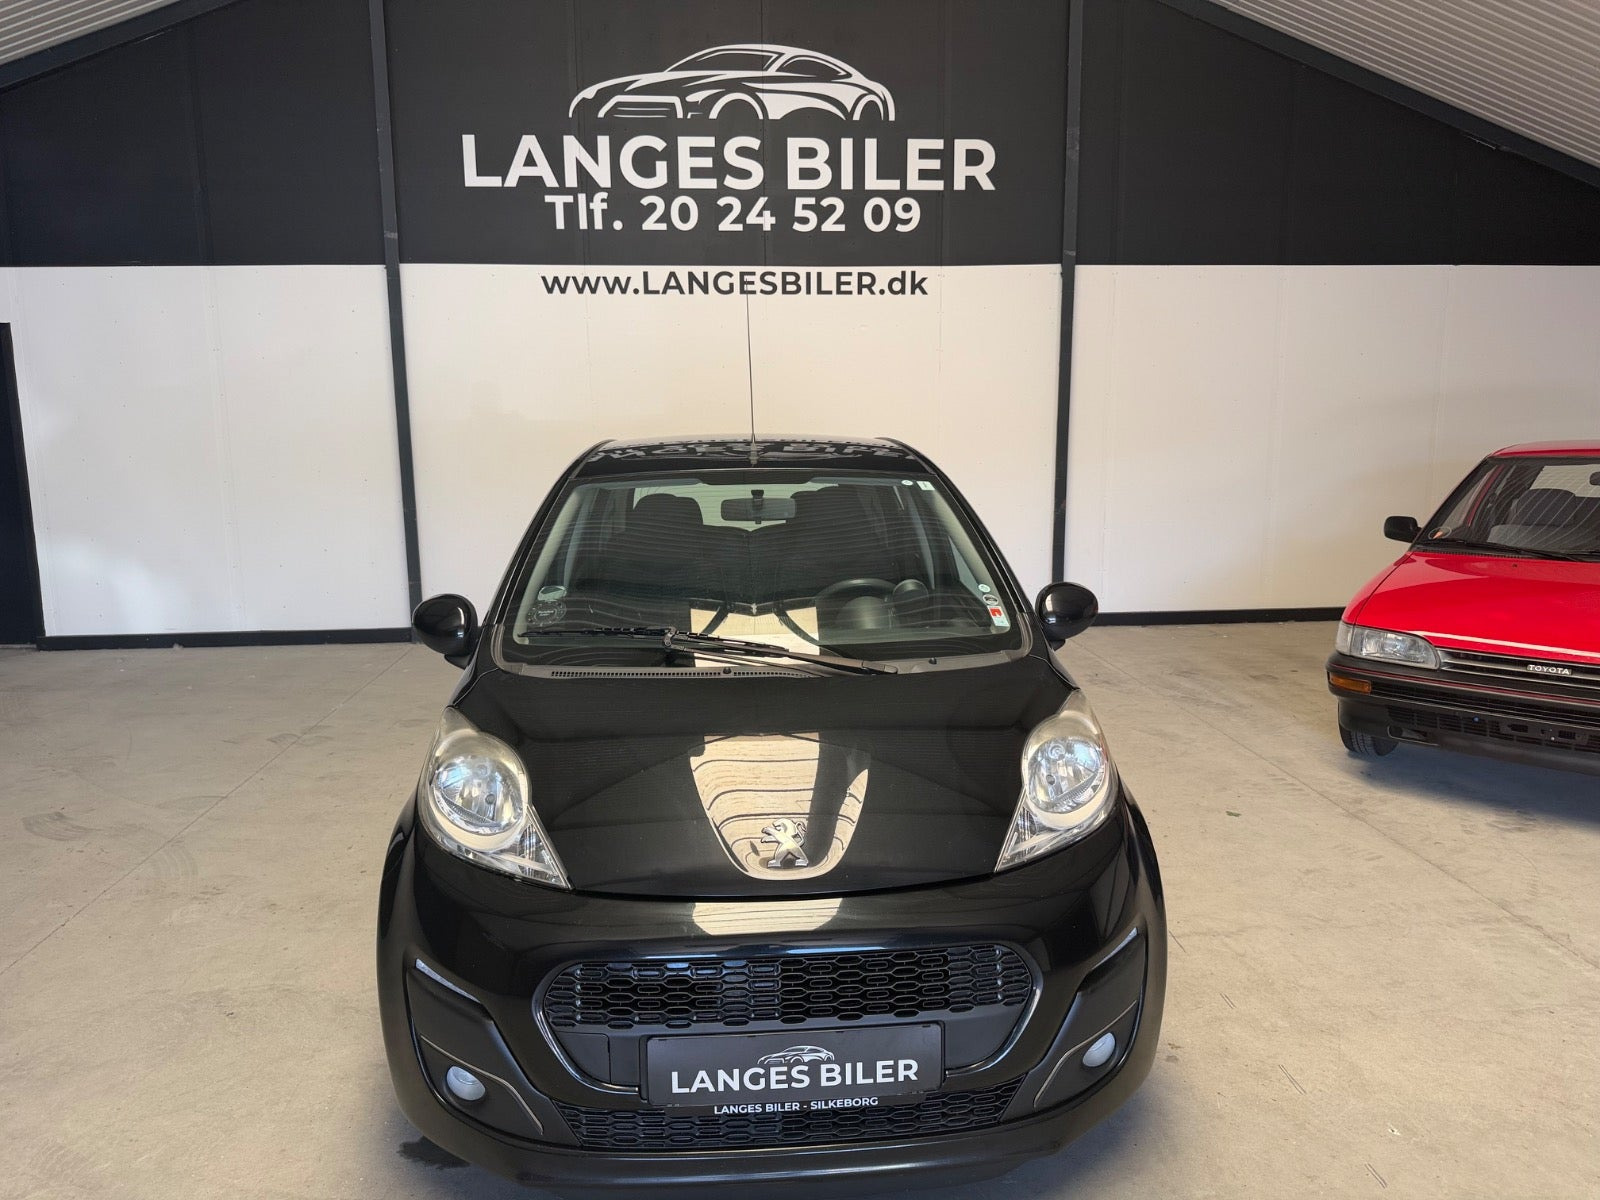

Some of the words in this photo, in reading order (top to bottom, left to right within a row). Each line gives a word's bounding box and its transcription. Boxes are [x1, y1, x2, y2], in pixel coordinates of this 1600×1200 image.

[461, 134, 764, 190] LANGES
[786, 136, 996, 191] BILER
[544, 191, 624, 231] Tlf.
[639, 195, 699, 232] 20
[716, 195, 776, 232] 24
[792, 196, 846, 233] 52
[863, 196, 921, 233] 09
[540, 270, 929, 296] www.LANGESBILER.dk
[1529, 664, 1570, 675] TOYOTA
[671, 1064, 811, 1094] LANGES
[820, 1058, 919, 1087] BILER
[714, 1103, 763, 1115] LANGES
[765, 1102, 800, 1113] BILER
[810, 1096, 879, 1110] SILKEBORG
